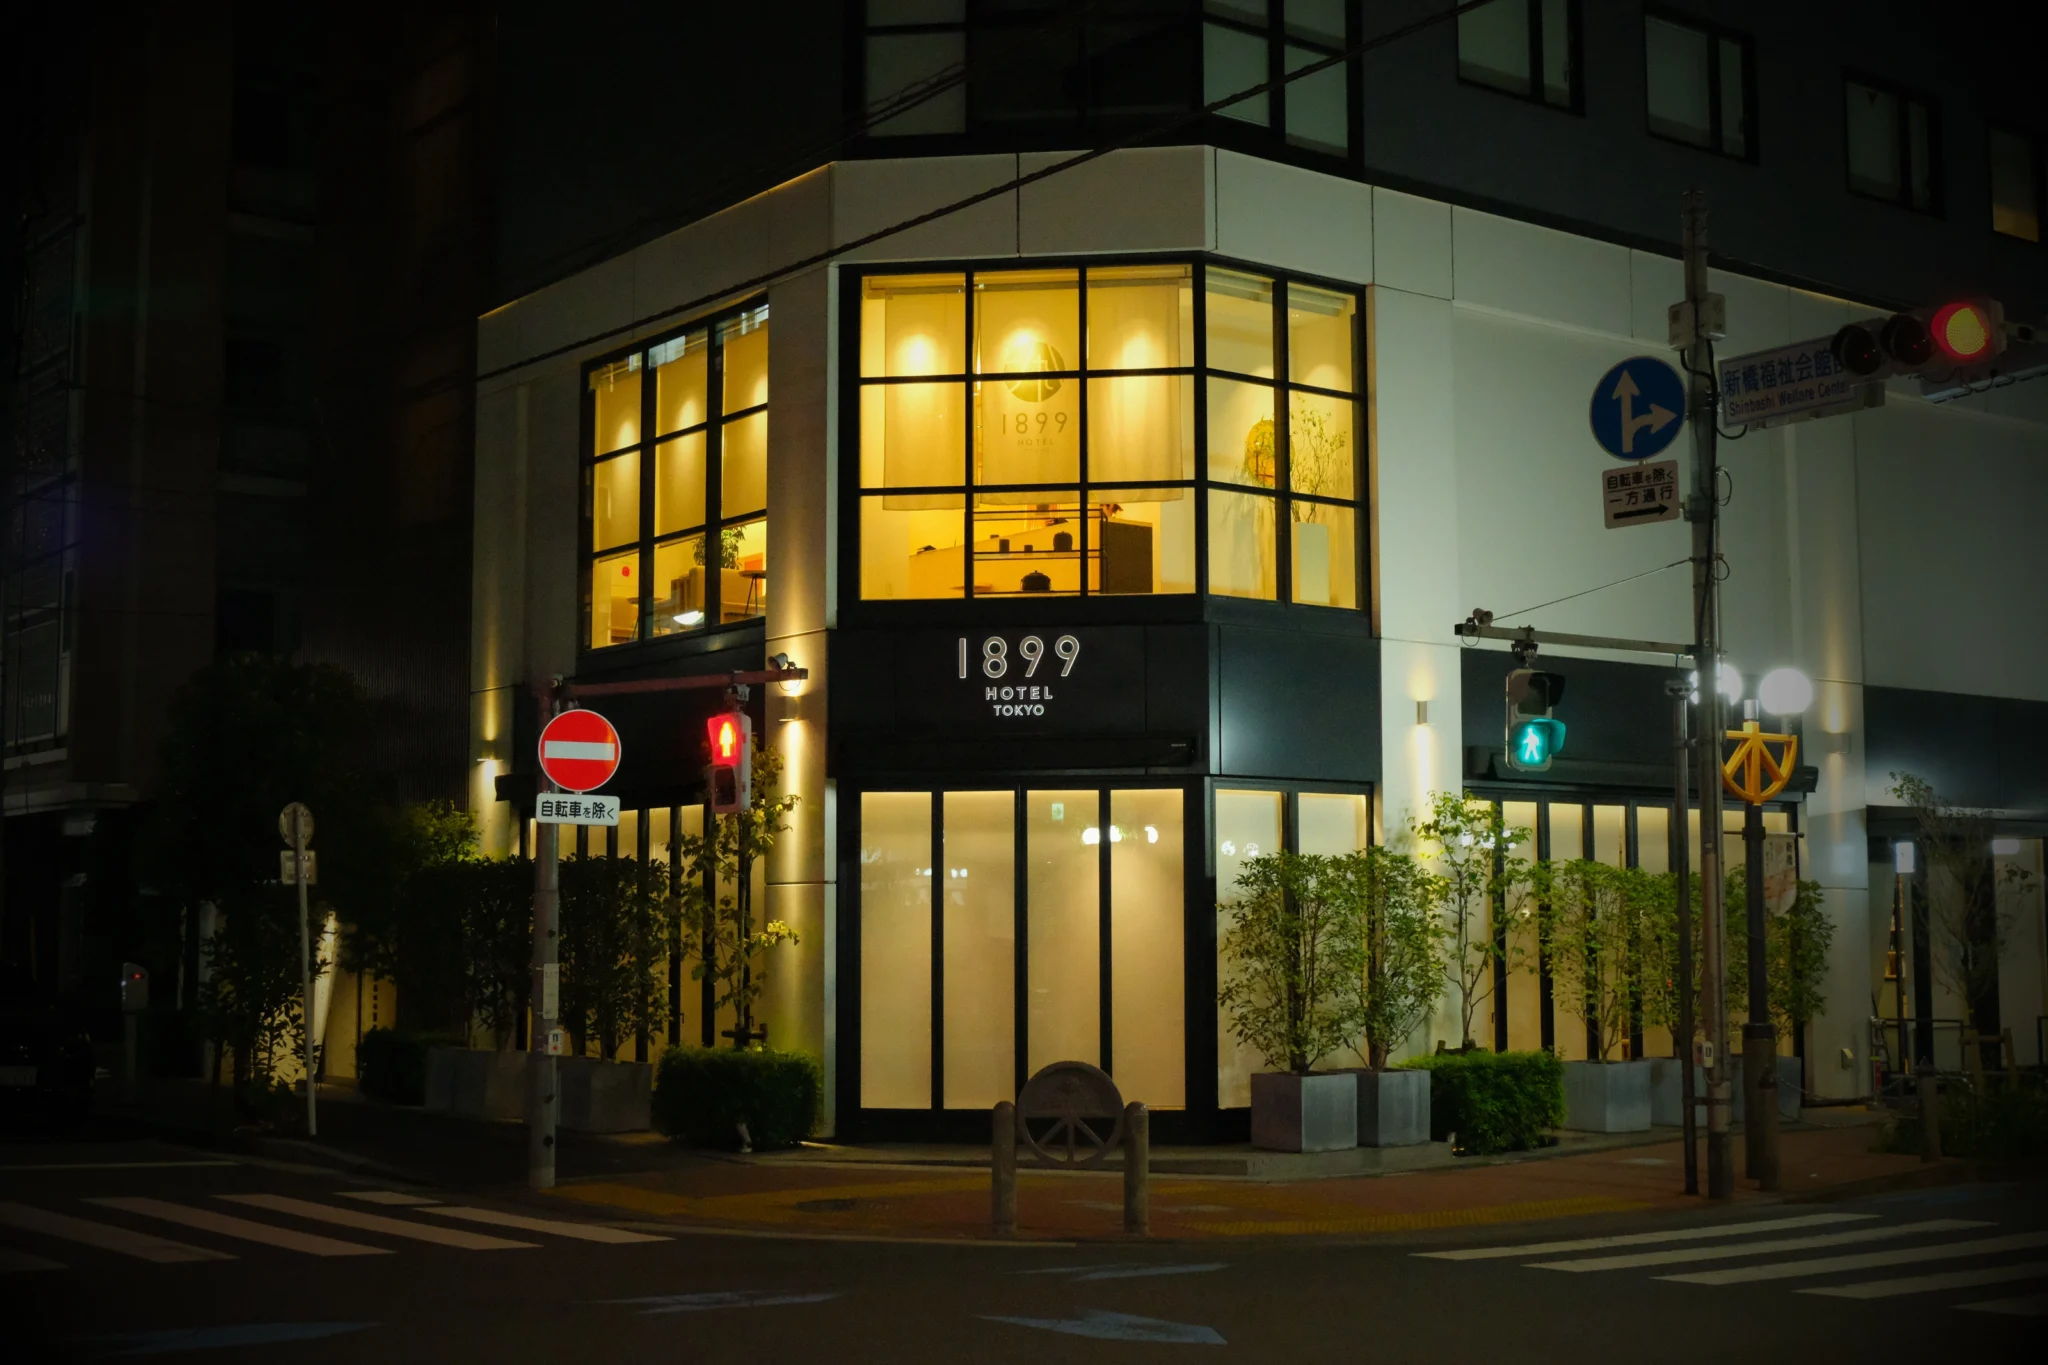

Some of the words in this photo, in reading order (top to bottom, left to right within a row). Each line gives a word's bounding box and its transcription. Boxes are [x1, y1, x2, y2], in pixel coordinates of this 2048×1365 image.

[1729, 394, 1776, 417] Shinbashi
[1778, 387, 1815, 405] Welfare
[1002, 411, 1068, 435] 1899
[1017, 438, 1055, 447] HOTEL
[1607, 468, 1674, 490] 自転車を除く
[1609, 486, 1674, 506] 一方通行
[958, 634, 1080, 679] 1899
[985, 685, 1054, 701] HOTEL
[993, 703, 1045, 717] TOKYO
[541, 799, 615, 820] 自転車を除く
